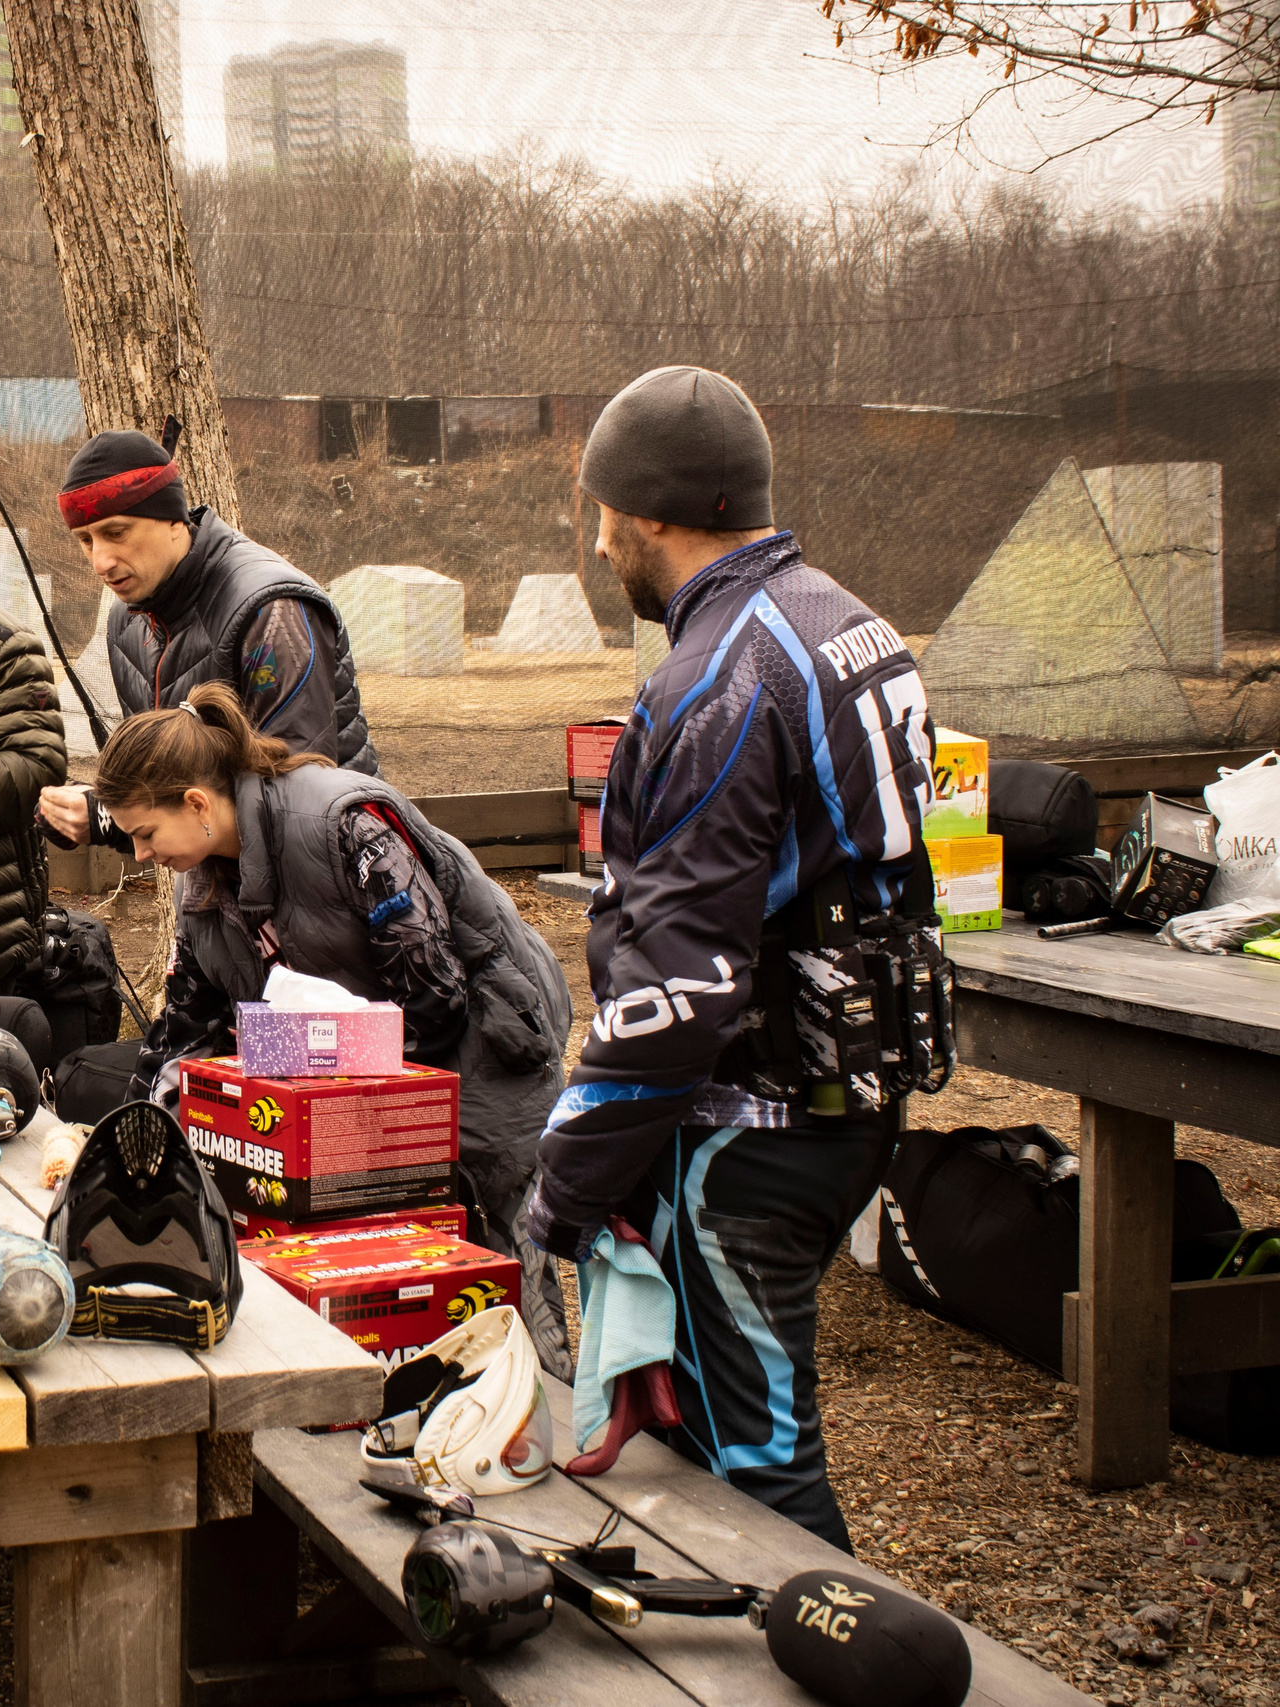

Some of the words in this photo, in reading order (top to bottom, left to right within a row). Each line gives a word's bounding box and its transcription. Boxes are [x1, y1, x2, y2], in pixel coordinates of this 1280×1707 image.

[1199, 827, 1210, 853] ROTOR
[312, 1026, 333, 1036] Frau
[188, 1108, 214, 1124] Paintballs
[188, 1125, 284, 1178] BUMBLEBEE
[411, 1287, 431, 1296] STARCH
[796, 1594, 858, 1644] TAC
